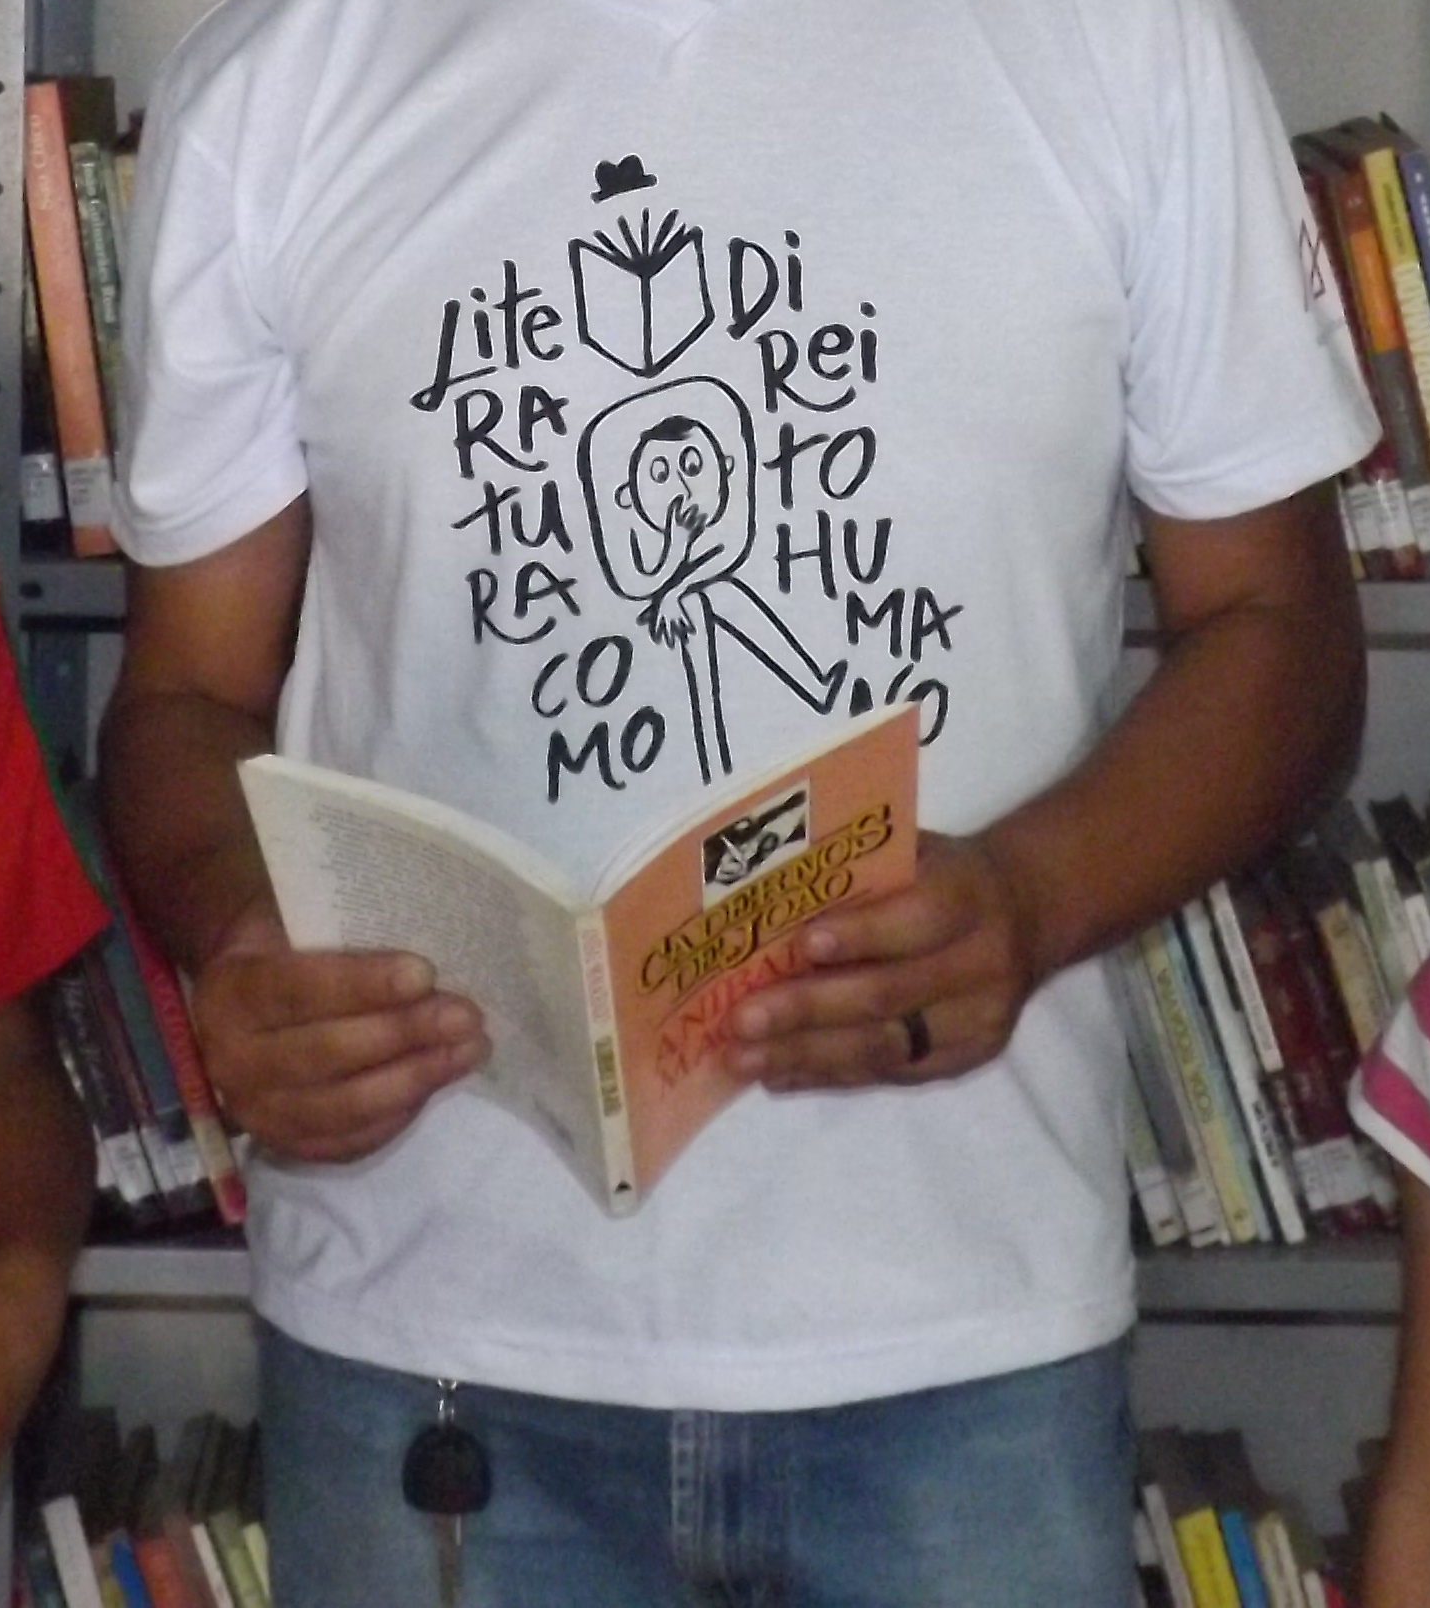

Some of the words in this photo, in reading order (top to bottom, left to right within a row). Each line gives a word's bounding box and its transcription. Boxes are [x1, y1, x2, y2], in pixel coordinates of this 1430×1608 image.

[727, 229, 803, 340] Di
[411, 258, 564, 411] Lite
[755, 301, 877, 413] Rei
[453, 385, 569, 479] RA
[774, 509, 892, 599] HU
[467, 561, 581, 646] RA
[846, 587, 964, 662] MA
[531, 634, 633, 718] CO
[547, 705, 666, 802] MO
[637, 804, 894, 996] CADERNOS
